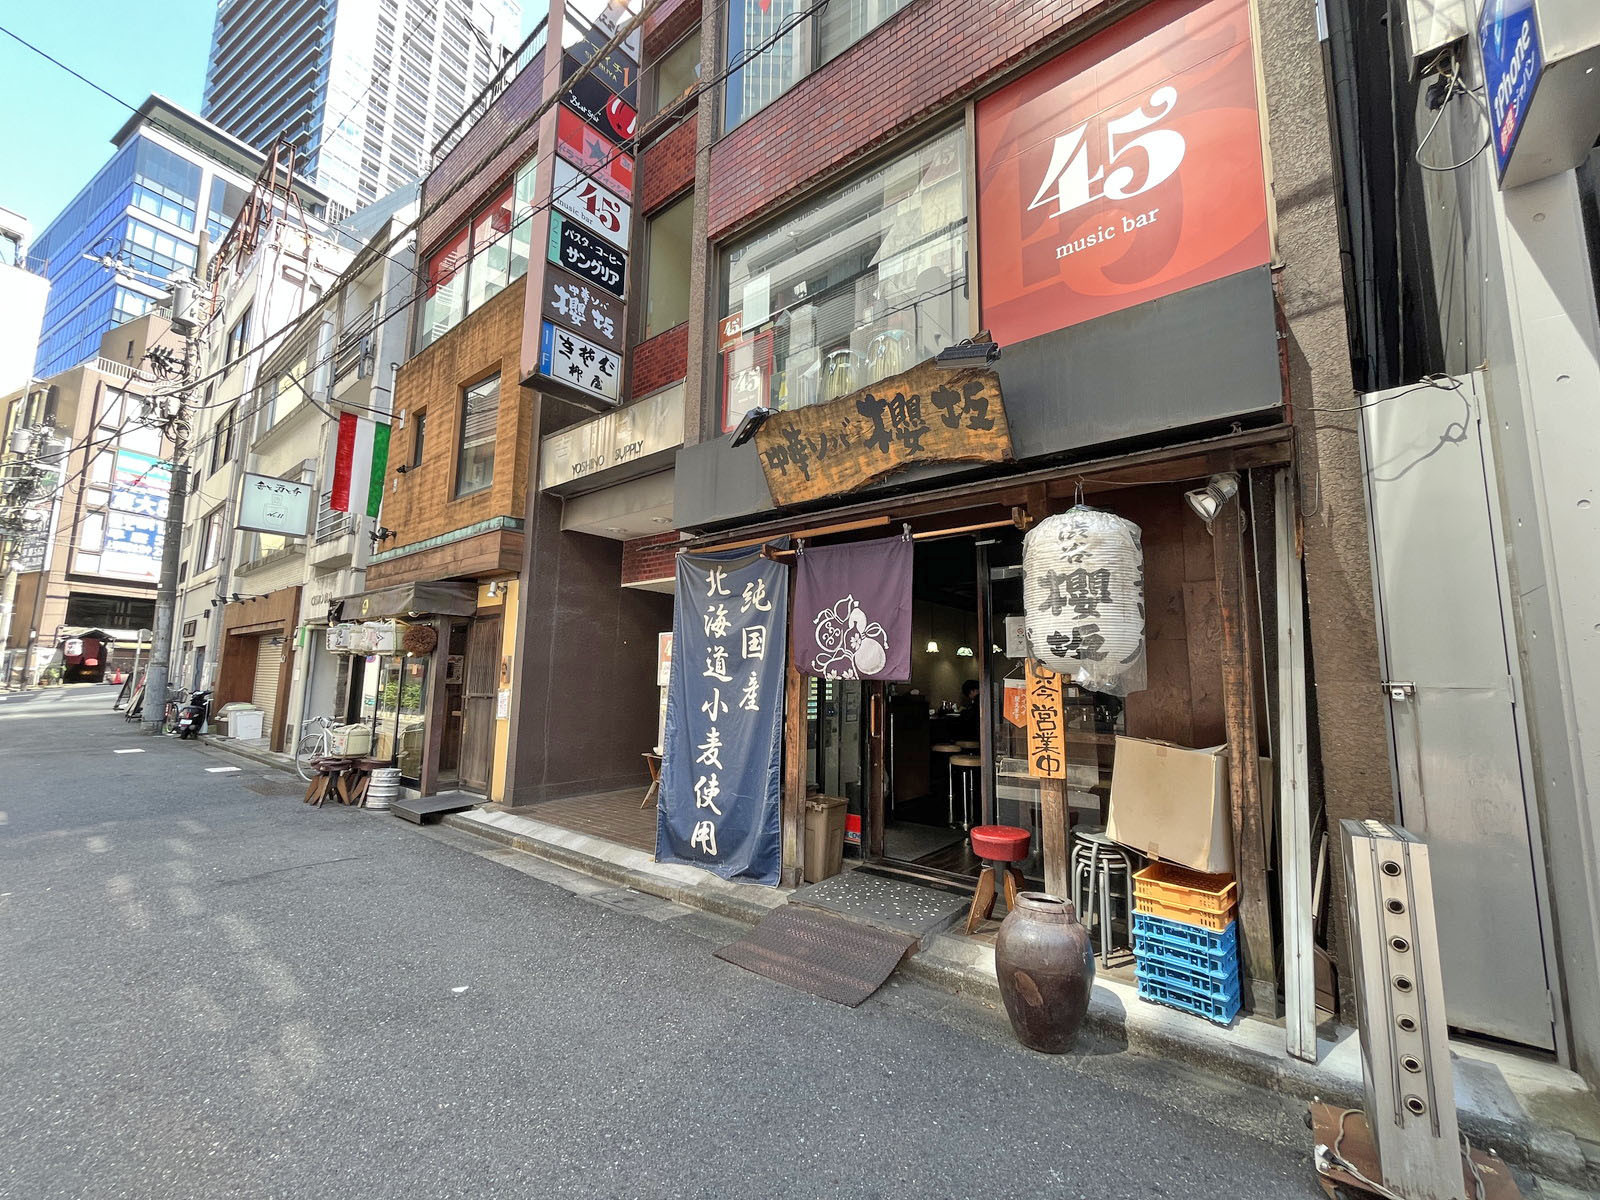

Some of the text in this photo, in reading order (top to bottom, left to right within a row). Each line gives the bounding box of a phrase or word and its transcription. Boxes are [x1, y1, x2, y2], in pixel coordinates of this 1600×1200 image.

[1027, 86, 1186, 218] 45
[557, 199, 593, 225] music bar
[576, 182, 621, 233] 45
[1055, 208, 1159, 259] music bar
[566, 246, 620, 286] サングリア
[571, 440, 644, 476] YOSHINO SUPPLY
[766, 416, 852, 482] 中華ソバ
[738, 578, 772, 712] 純国産
[690, 565, 734, 856] 北海道小麦使用
